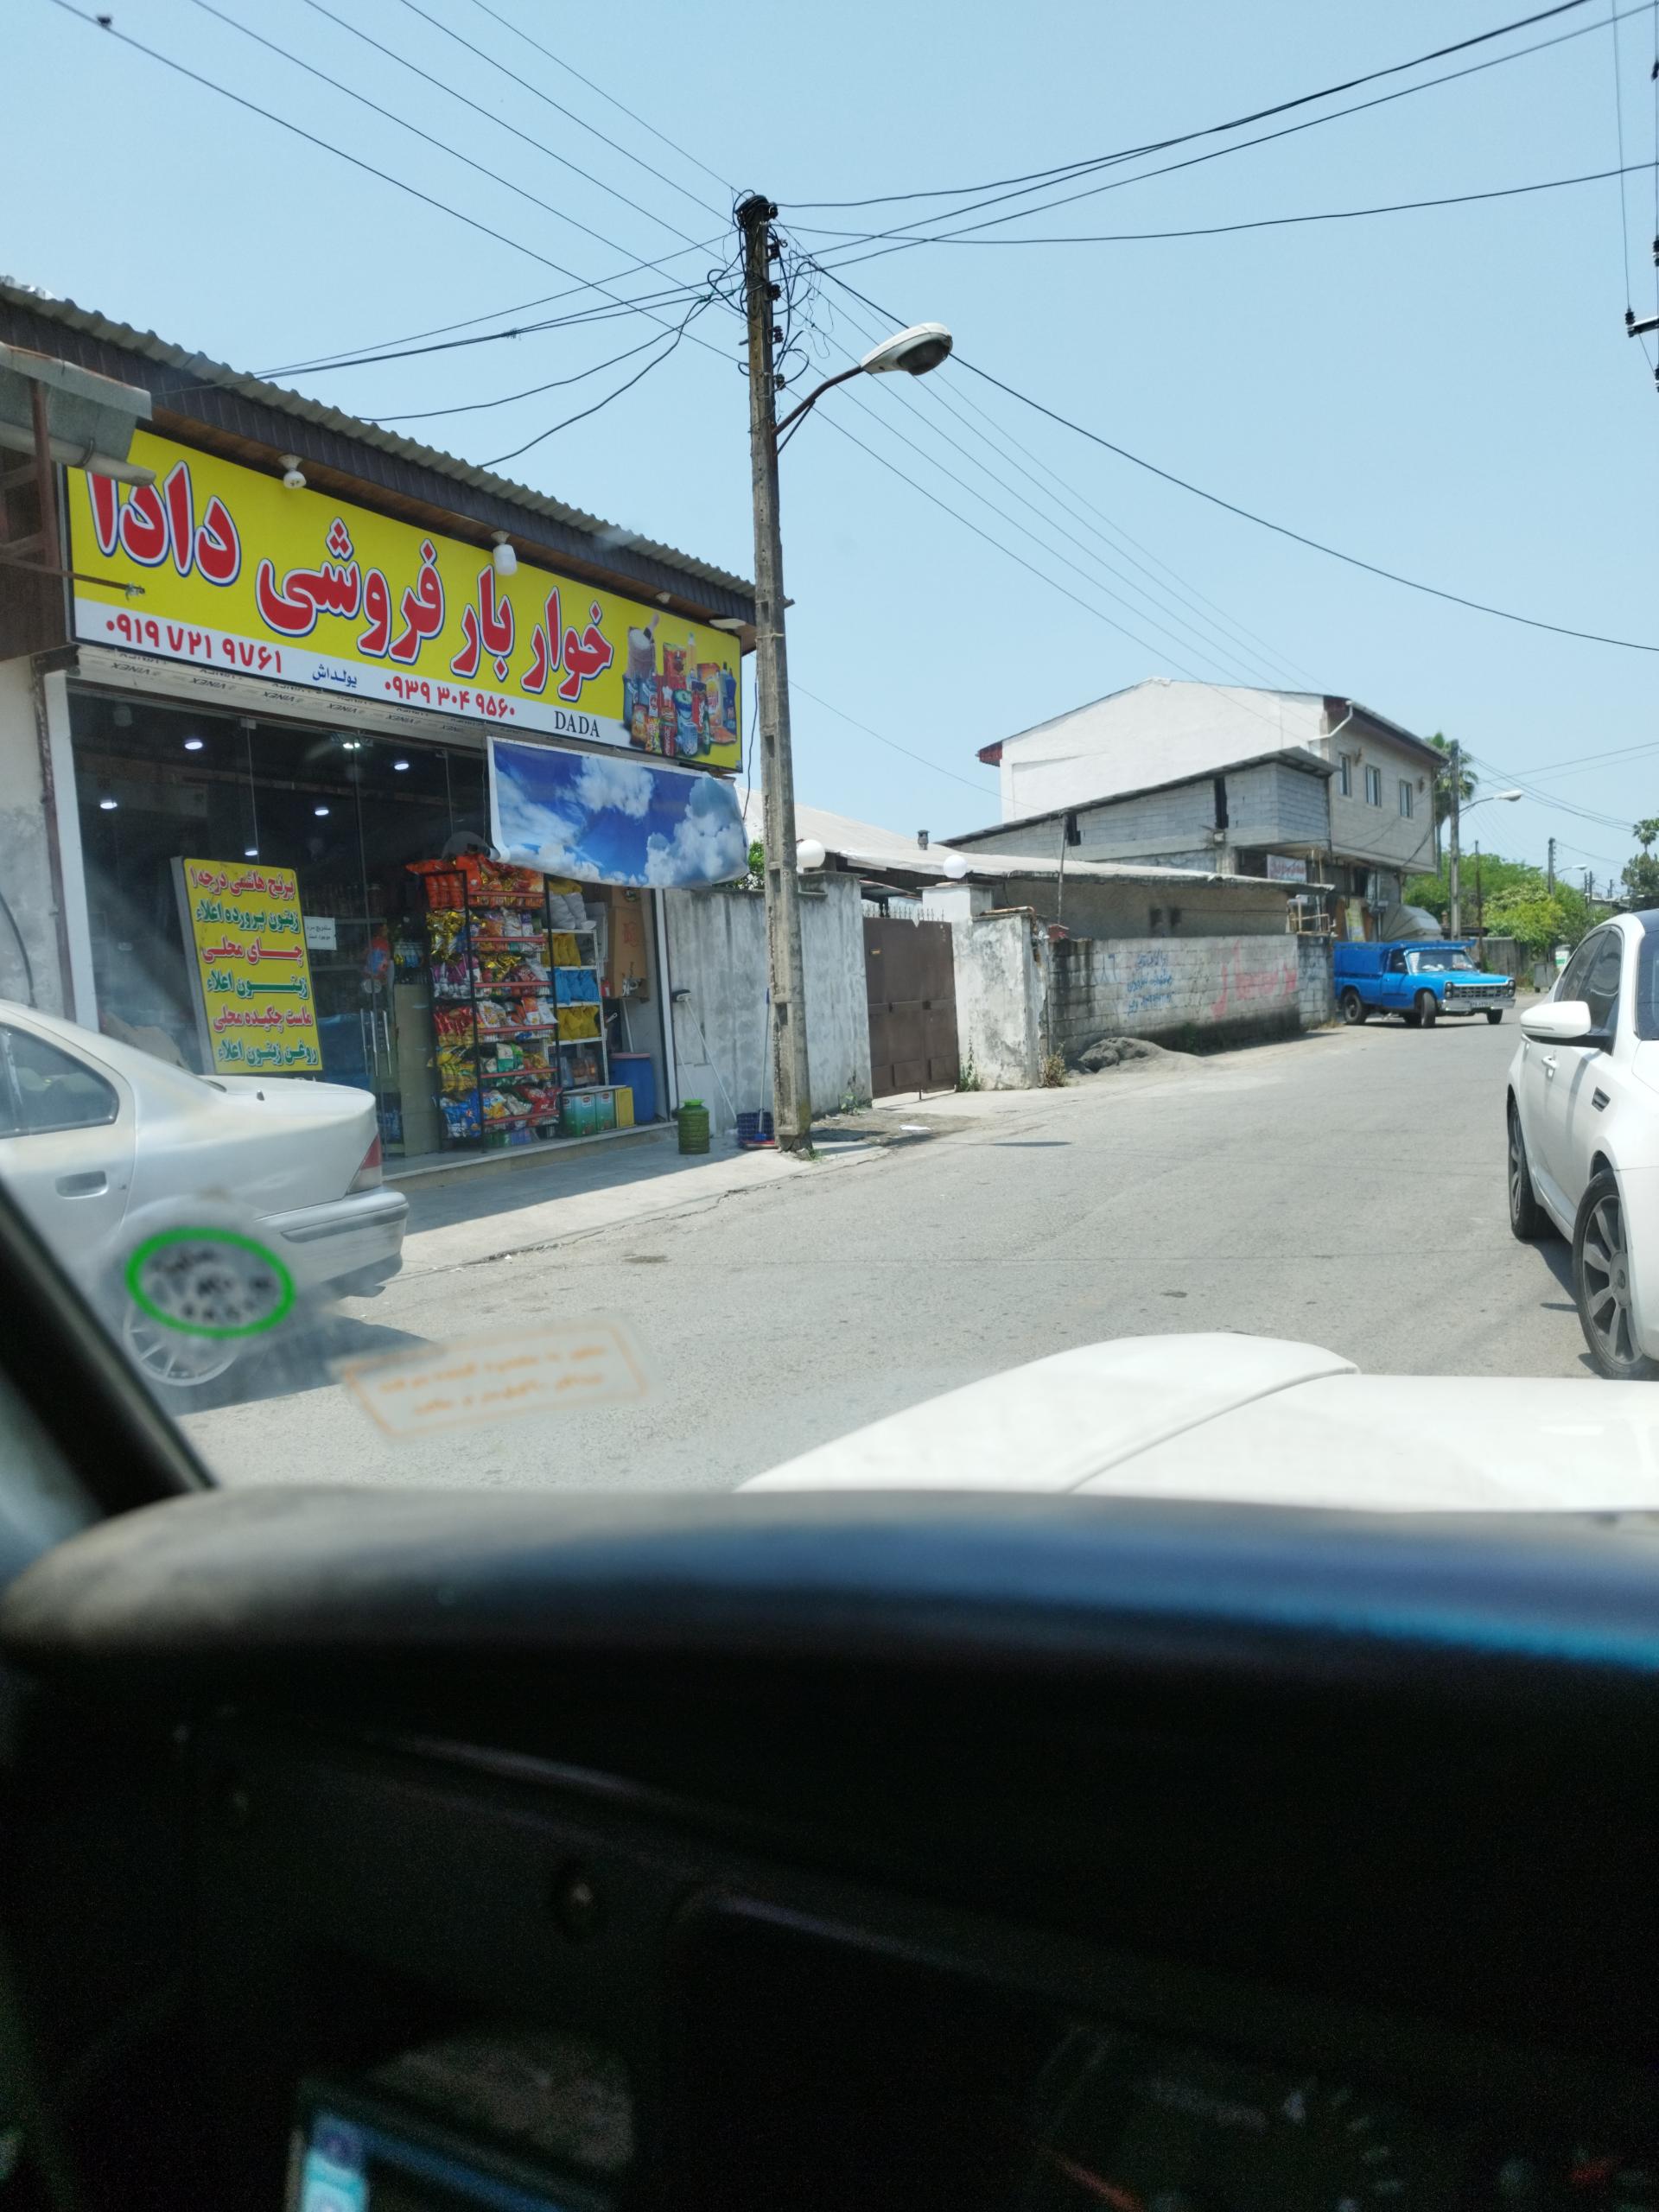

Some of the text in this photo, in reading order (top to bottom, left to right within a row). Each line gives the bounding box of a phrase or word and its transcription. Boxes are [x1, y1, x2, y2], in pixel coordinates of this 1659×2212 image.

[85, 460, 242, 588] دادا
[255, 516, 446, 666] فروشی
[554, 710, 601, 738] DADA
[268, 872, 296, 900] برنج
[269, 908, 301, 934] زیتون
[201, 934, 303, 968] چای محلی
[236, 974, 309, 1000] زیتون
[213, 1003, 243, 1033] محلی
[285, 1005, 314, 1027] ماست
[245, 1042, 283, 1067] زیتون
[283, 1039, 319, 1065] روغن
